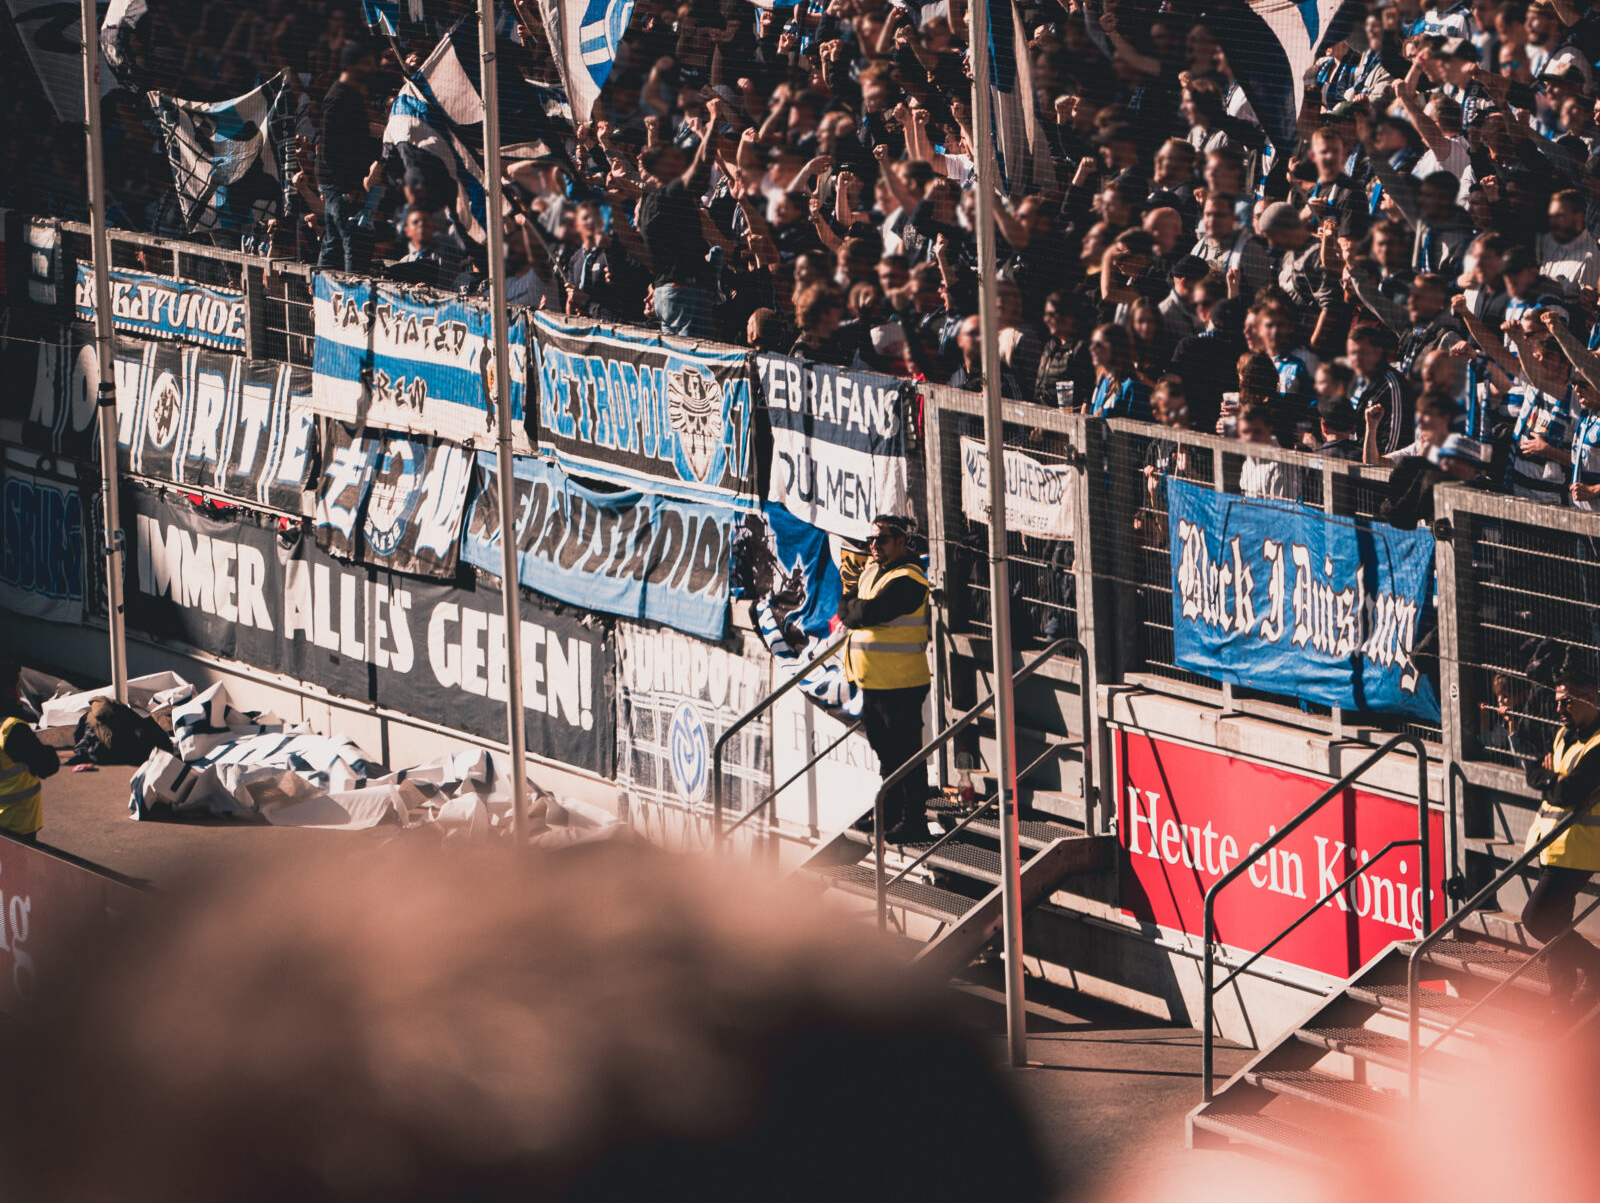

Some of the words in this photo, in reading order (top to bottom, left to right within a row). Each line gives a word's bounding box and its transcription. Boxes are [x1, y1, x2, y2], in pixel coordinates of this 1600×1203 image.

[75, 272, 246, 340] JGSPUNDE
[360, 367, 428, 417] REW
[966, 448, 1067, 506] WEUHERDE
[137, 514, 273, 632] IMMER
[284, 559, 414, 674] ALLES
[1177, 518, 1257, 636] Block
[1291, 541, 1420, 695] Duisburg
[792, 710, 881, 773] Fanku
[1127, 785, 1240, 876] Heute
[1247, 824, 1307, 900] ein
[1313, 835, 1435, 940] König
